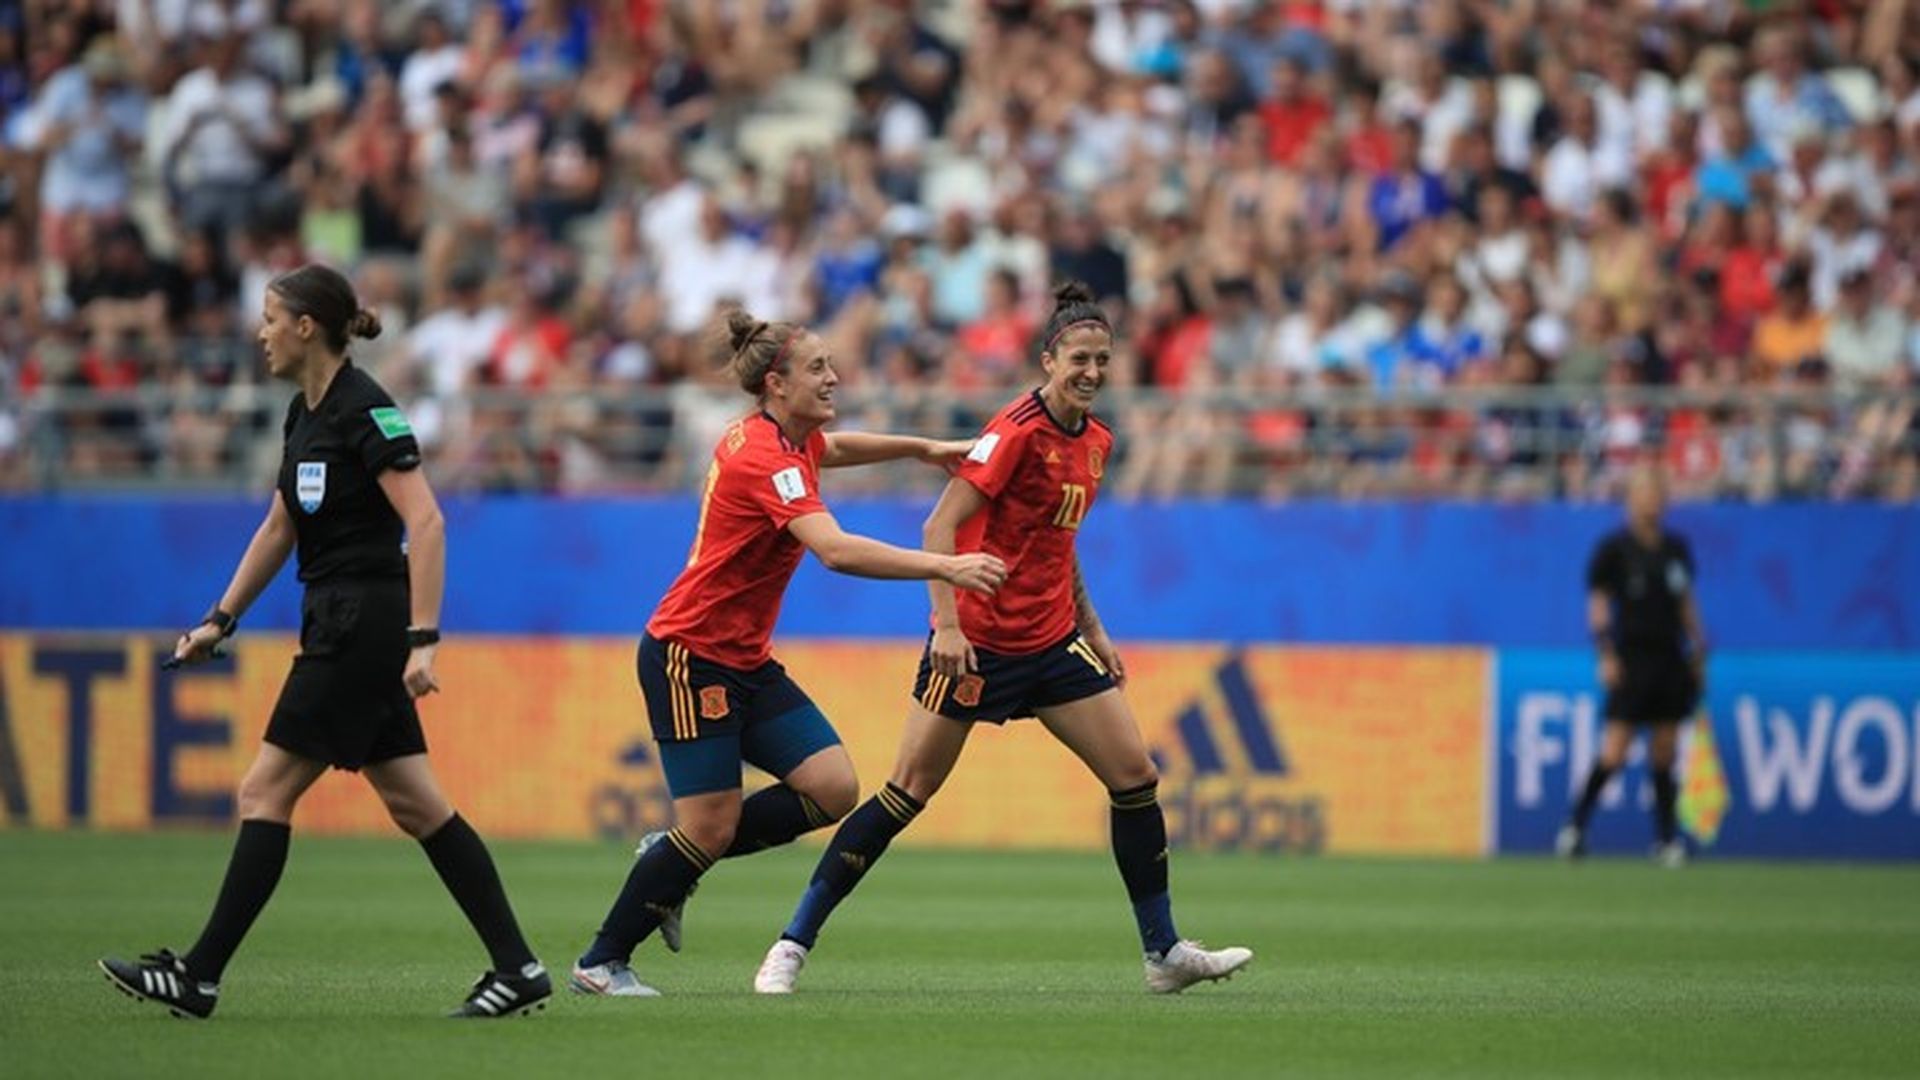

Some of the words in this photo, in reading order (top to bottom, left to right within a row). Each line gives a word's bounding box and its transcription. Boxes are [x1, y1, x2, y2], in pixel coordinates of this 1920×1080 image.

[1053, 483, 1086, 529] 10
[1735, 694, 1920, 814] WO
[1165, 774, 1326, 856] didas
